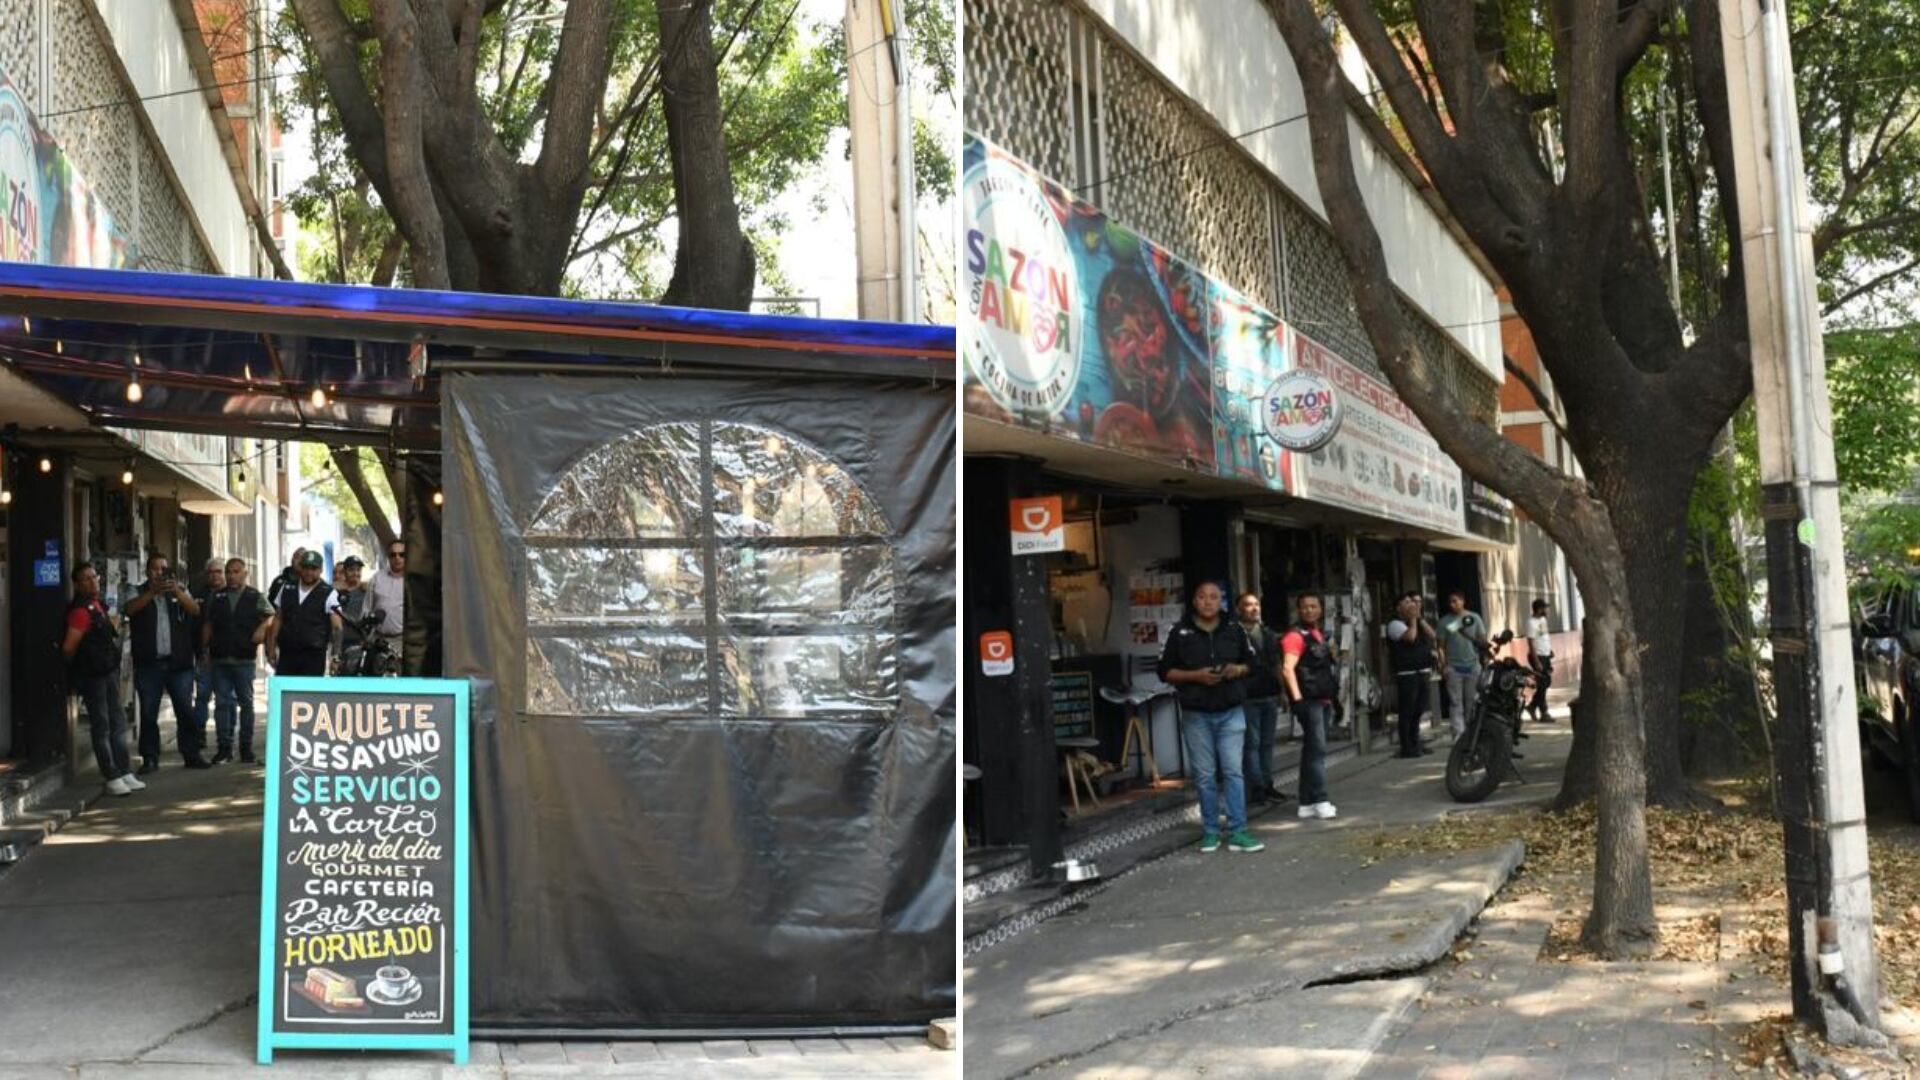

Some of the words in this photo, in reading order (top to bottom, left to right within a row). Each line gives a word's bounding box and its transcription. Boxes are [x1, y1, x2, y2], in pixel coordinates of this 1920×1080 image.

[1270, 387, 1332, 413] SAZÓN
[291, 701, 436, 744] PAQUETE
[290, 729, 441, 771] DESAYUNO
[291, 775, 441, 805] SERVICIO
[289, 818, 319, 834] LA
[296, 807, 310, 820] A
[319, 804, 437, 840] Carta
[368, 836, 401, 860] del
[311, 862, 425, 878] GOURMET
[304, 879, 434, 897] CAFETERÍA
[284, 898, 351, 933] Pan
[348, 898, 442, 930] Recién
[284, 925, 433, 967] HORNEADO
